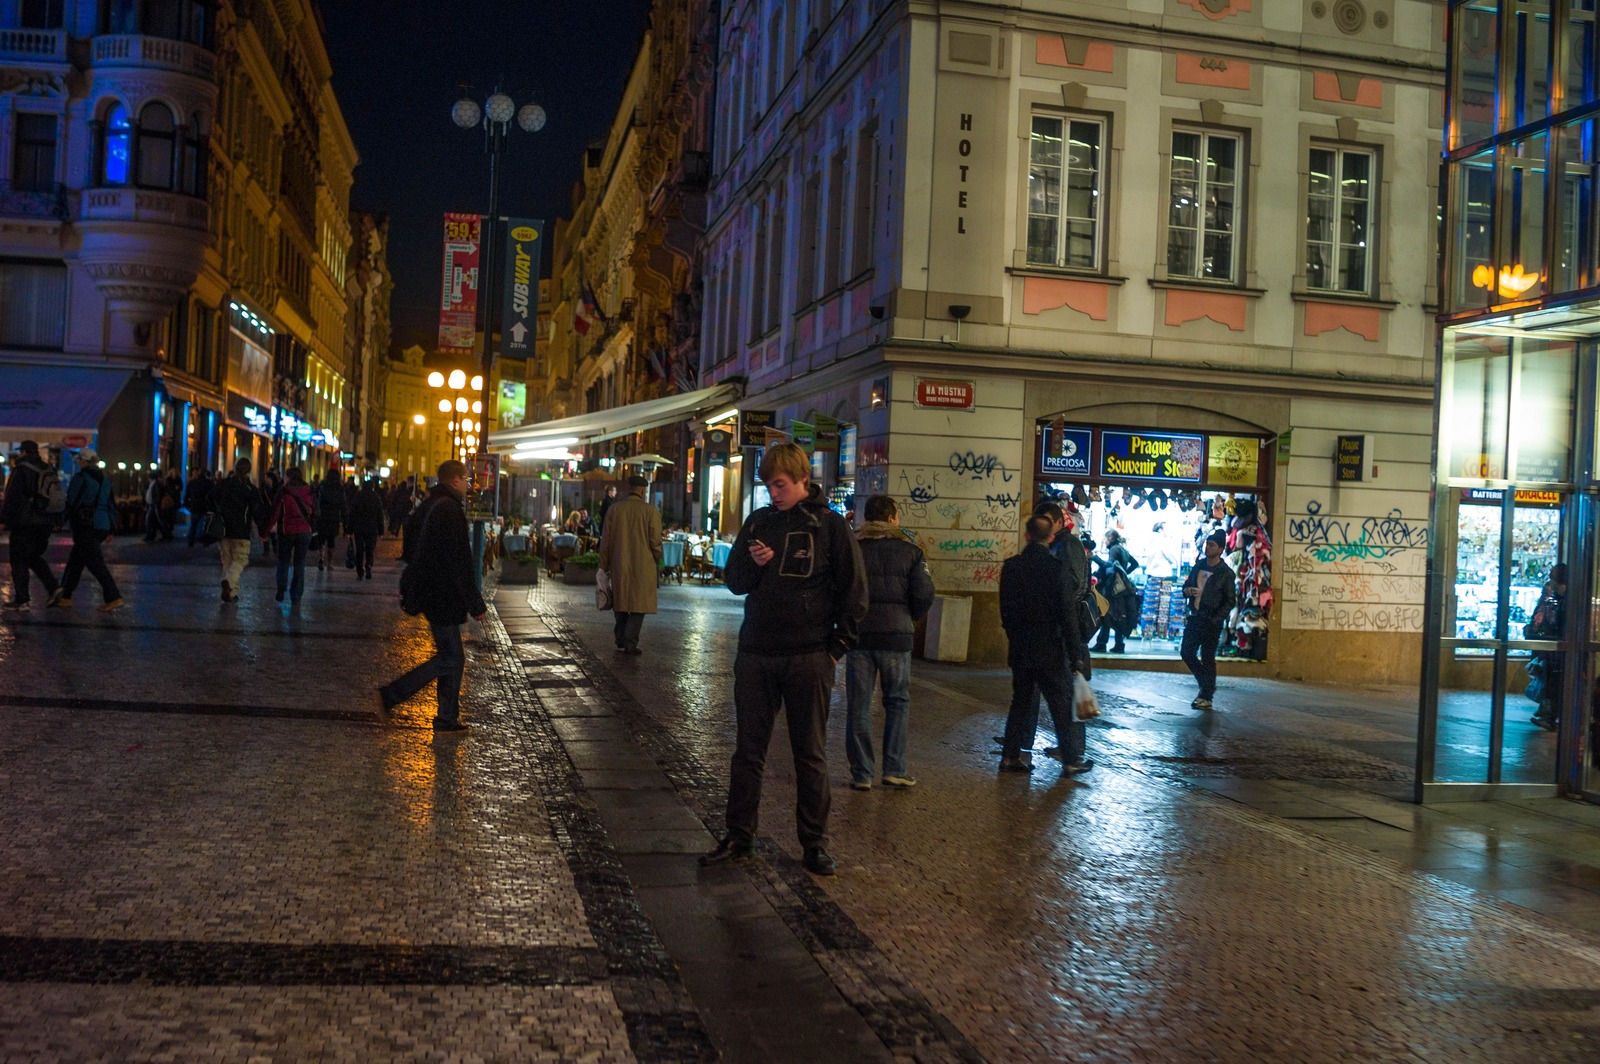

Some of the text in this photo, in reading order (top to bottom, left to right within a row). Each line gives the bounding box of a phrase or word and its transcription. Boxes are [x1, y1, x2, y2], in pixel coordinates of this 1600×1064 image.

[956, 113, 972, 234] HOTEL
[512, 243, 531, 319] SUBWAY
[925, 385, 967, 397] NA MŮSTKU
[1131, 436, 1172, 458] Prague
[1215, 440, 1252, 466] CAESAR CRYSTAL
[1341, 438, 1360, 451] Prague
[1046, 457, 1085, 468] PRECIOSA
[1107, 455, 1157, 476] Souvenir
[1339, 453, 1360, 465] Souvenir
[1342, 467, 1356, 479] Store
